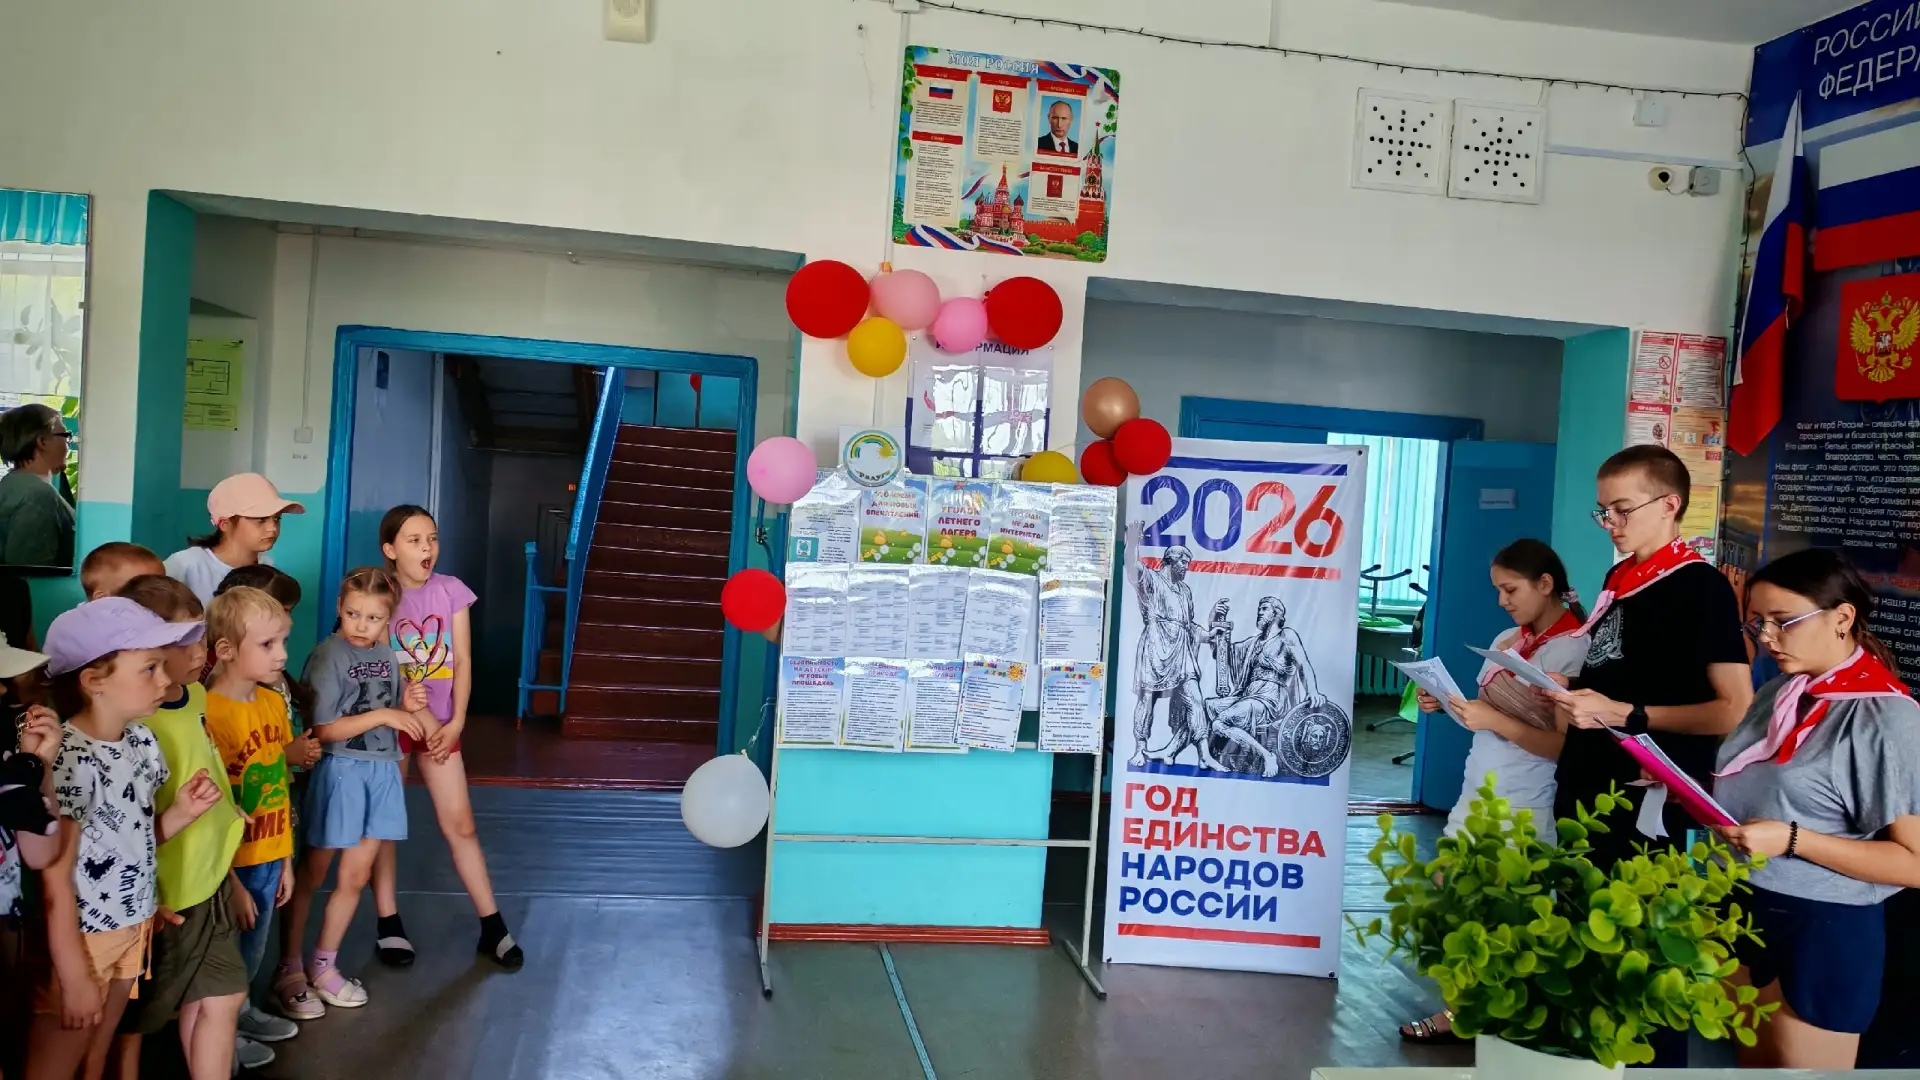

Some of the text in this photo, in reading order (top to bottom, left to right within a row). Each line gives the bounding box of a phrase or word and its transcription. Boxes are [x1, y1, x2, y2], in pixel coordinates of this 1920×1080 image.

[948, 53, 1039, 75] МОЯ РОССИЯ
[938, 516, 981, 527] ЛЕТНЕГО
[940, 527, 977, 538] ЛАГЕРЯ
[1141, 475, 1345, 558] 2026
[263, 723, 284, 744] CA
[1124, 782, 1199, 819] ГОД
[242, 808, 286, 843] AME
[1122, 817, 1327, 858] ЕДИНСТВА
[1120, 851, 1304, 891] НАРОДОВ
[1118, 885, 1278, 922] РОССИИ
